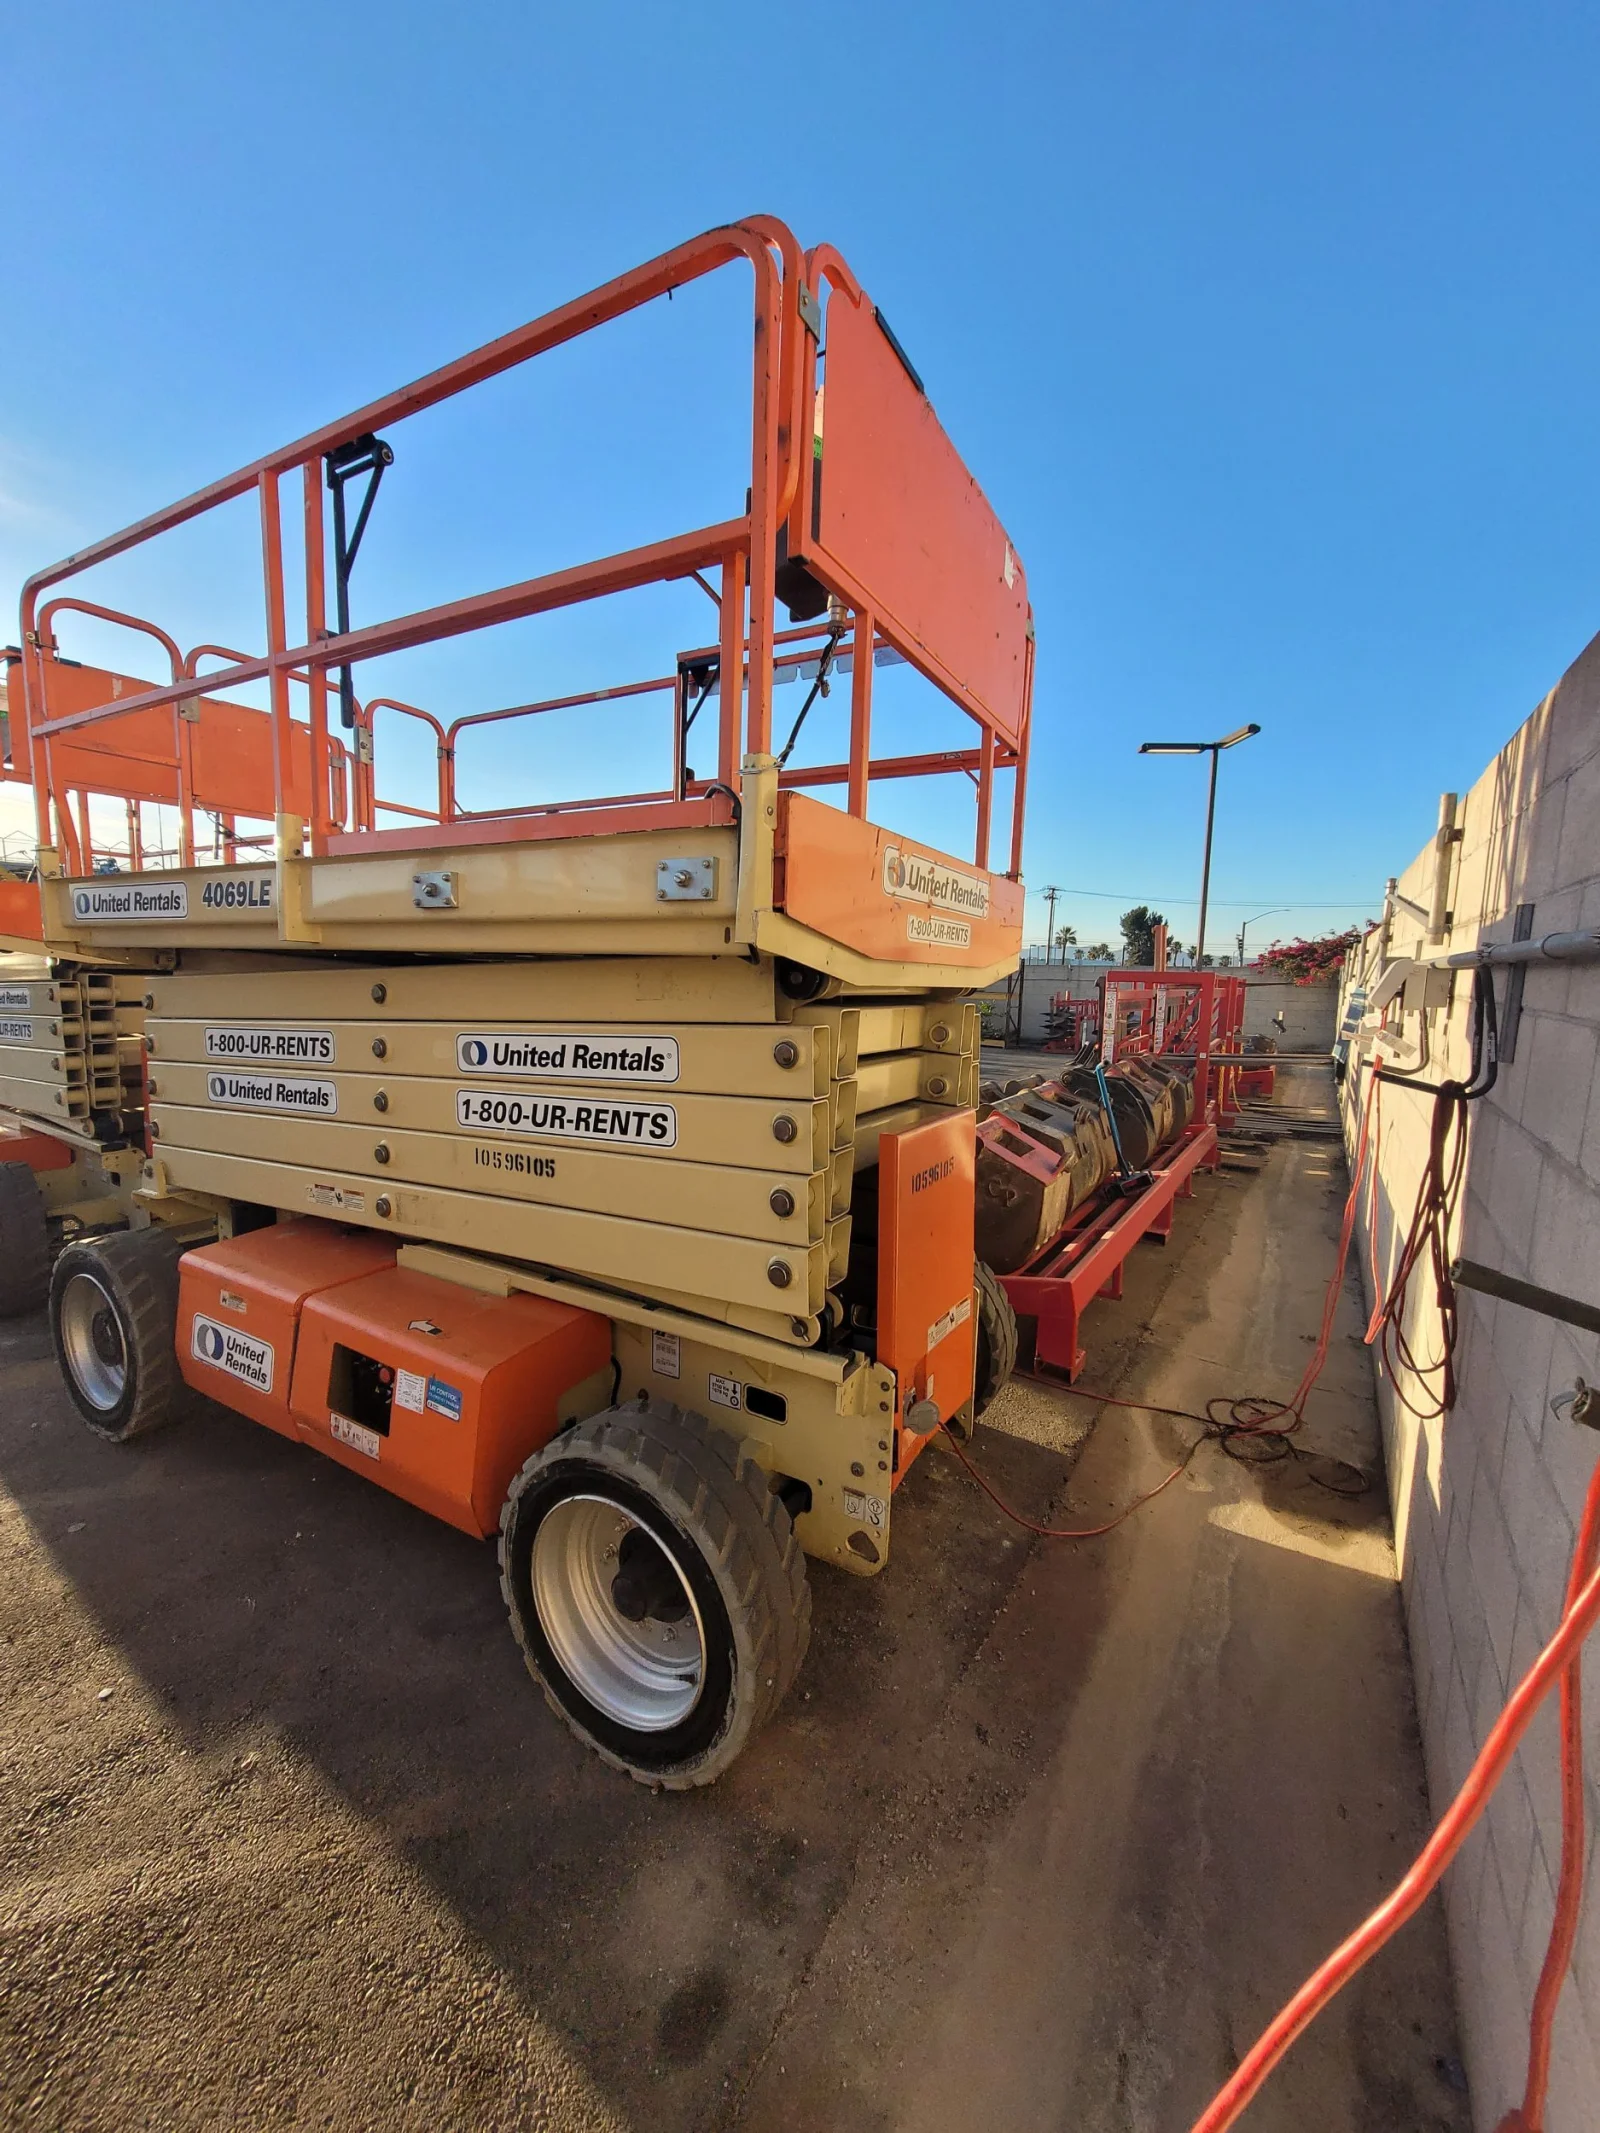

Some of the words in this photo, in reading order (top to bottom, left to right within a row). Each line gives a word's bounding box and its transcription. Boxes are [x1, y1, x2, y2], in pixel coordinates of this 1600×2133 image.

[92, 891, 131, 913] United
[133, 889, 181, 911] Rentals
[202, 879, 272, 908] 4069LE
[908, 863, 950, 900] United
[950, 878, 985, 910] Rentals
[909, 918, 969, 943] 1-800-UR-RENTS
[207, 1033, 331, 1058] 1-800-UR-RENTS
[492, 1043, 566, 1069] United
[571, 1044, 666, 1073] Rentals
[228, 1079, 273, 1102] United
[275, 1083, 330, 1108] Rentals
[461, 1098, 669, 1140] 1-800-UR-RENTS
[473, 1147, 556, 1179] 10596105
[912, 1156, 954, 1194] 10596105
[225, 1334, 265, 1365] United
[224, 1352, 268, 1385] Rentals
